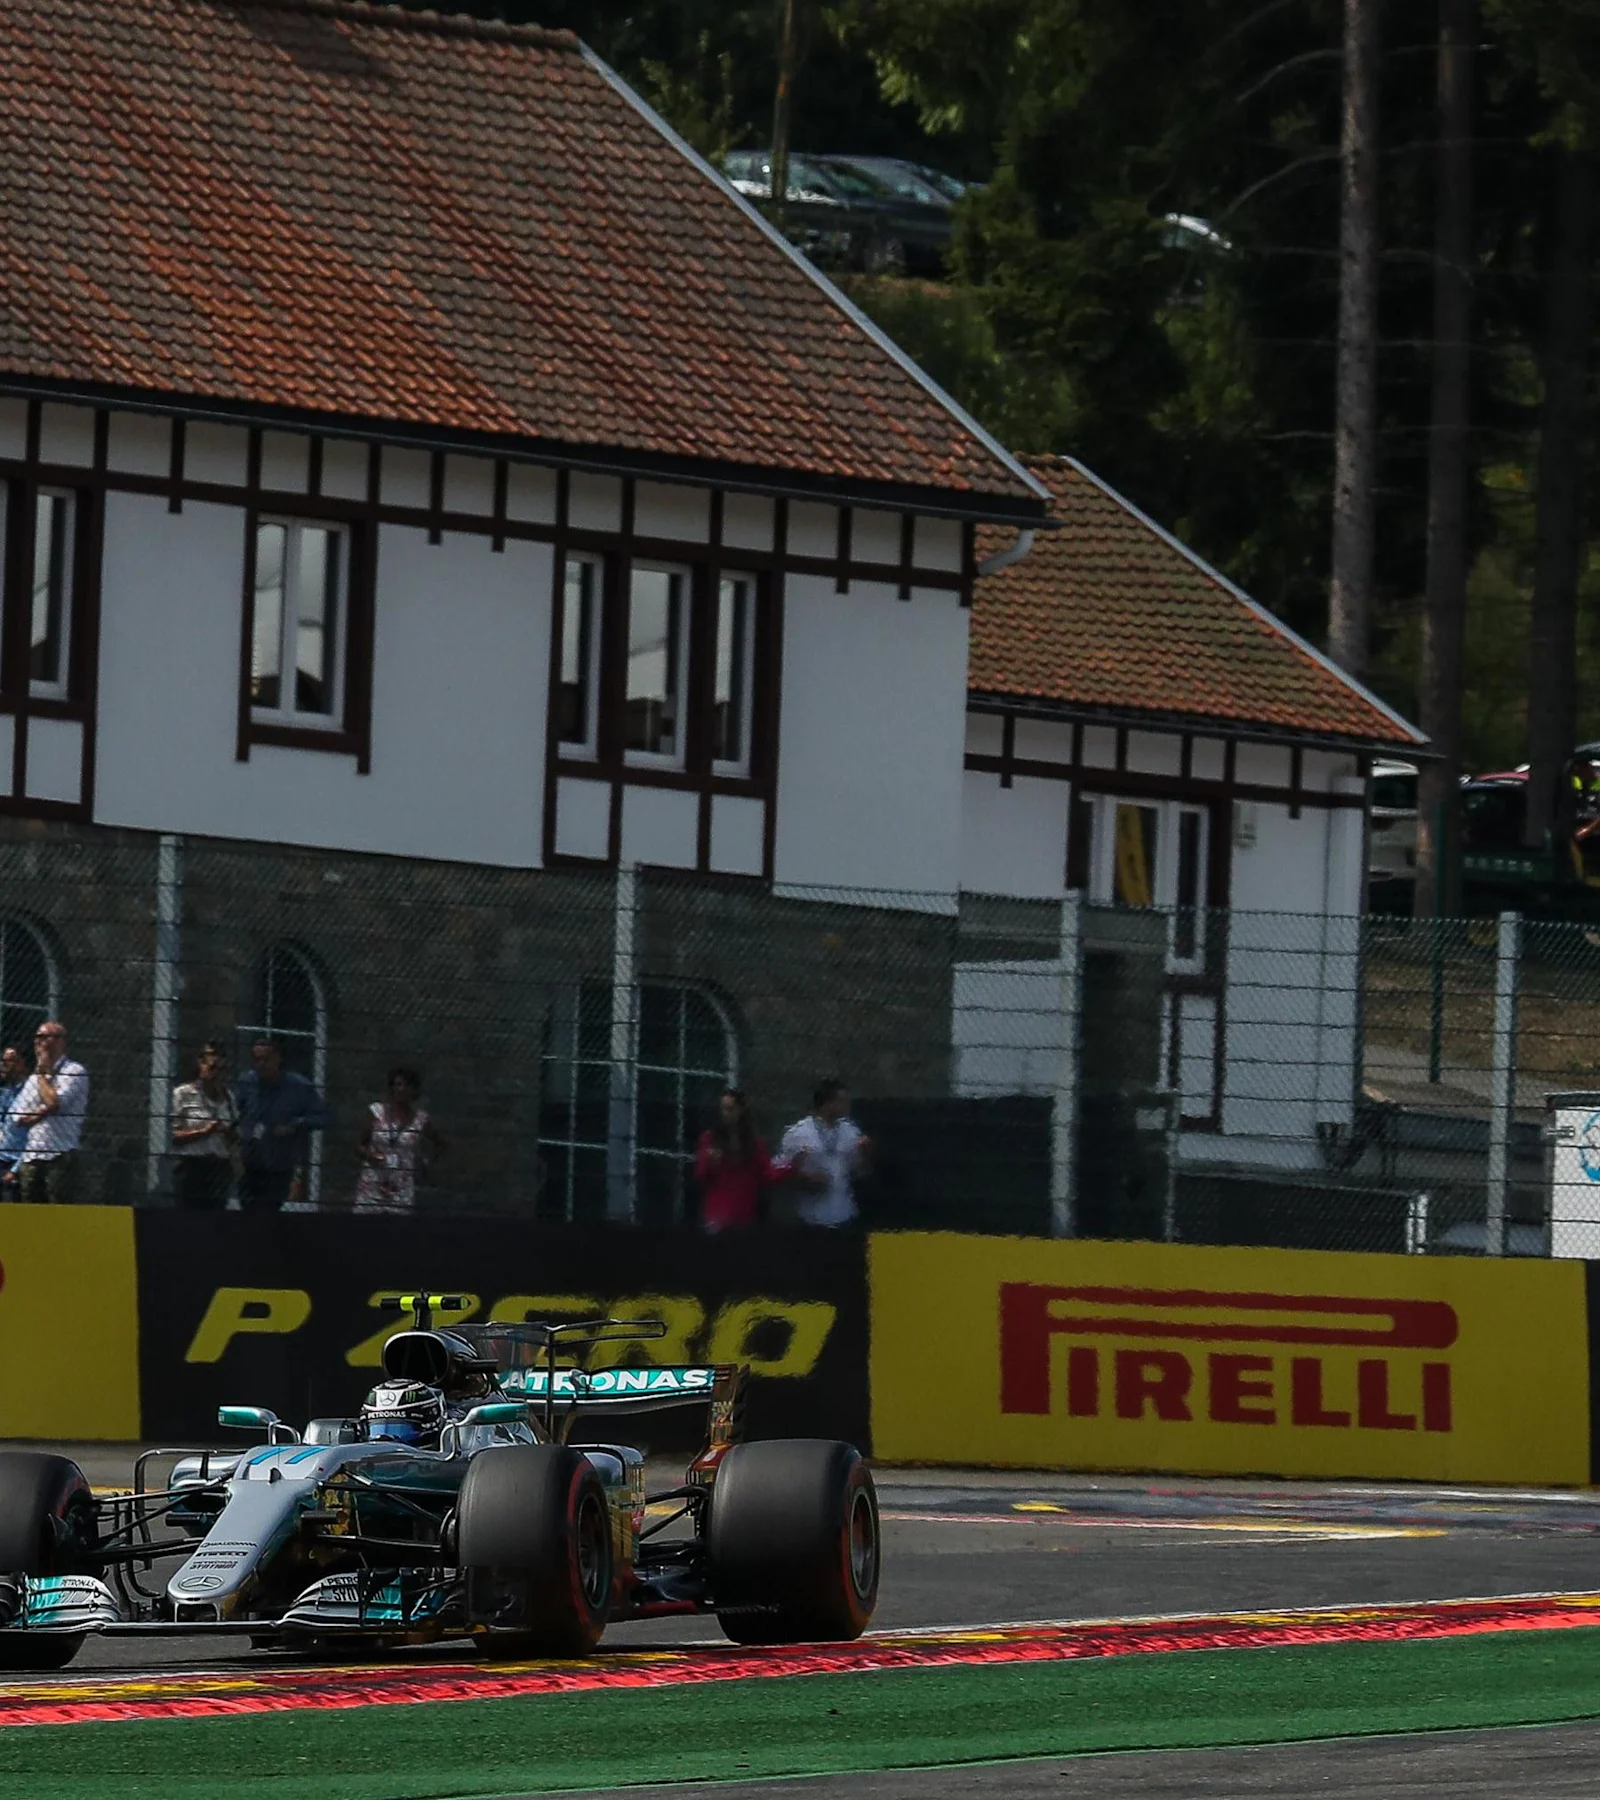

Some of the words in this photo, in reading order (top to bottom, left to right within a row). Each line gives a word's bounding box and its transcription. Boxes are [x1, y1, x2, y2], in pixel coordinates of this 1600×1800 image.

[186, 1287, 311, 1364] P
[1000, 1281, 1458, 1433] PIRELLI
[367, 1411, 407, 1419] PETRONAS
